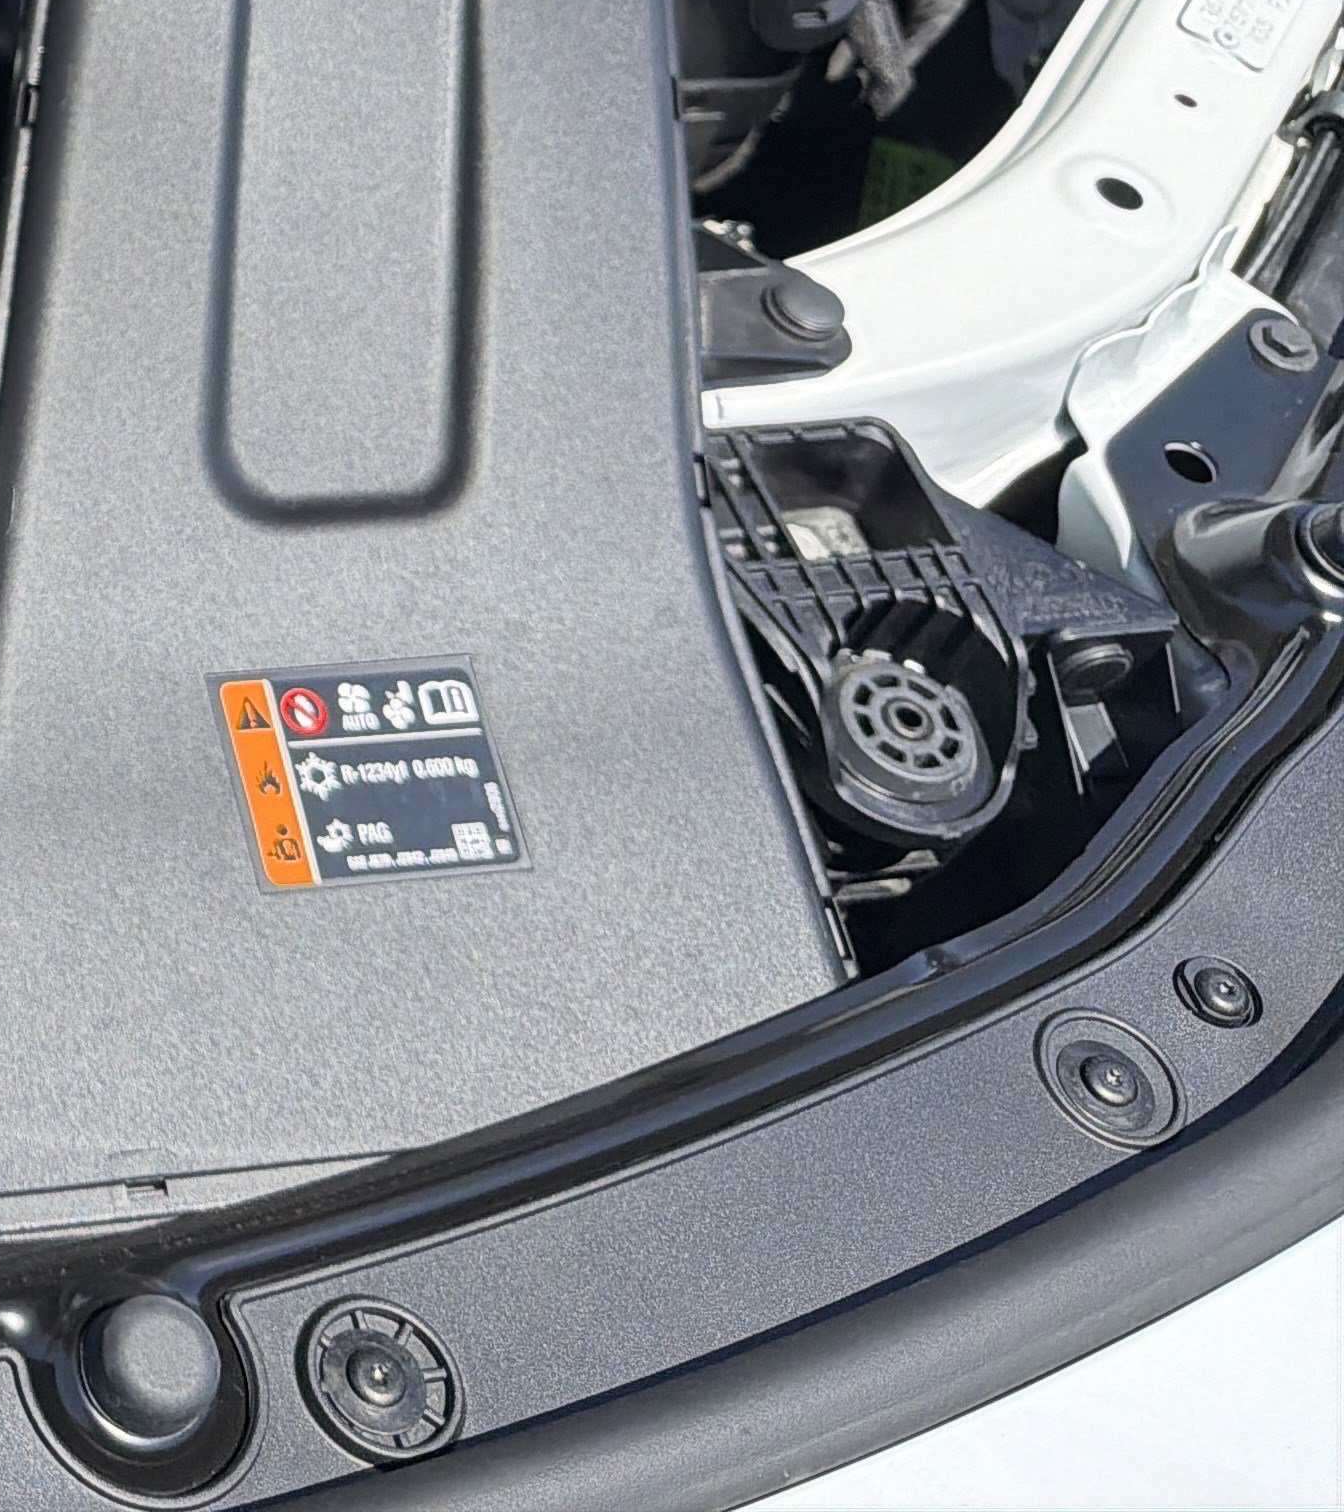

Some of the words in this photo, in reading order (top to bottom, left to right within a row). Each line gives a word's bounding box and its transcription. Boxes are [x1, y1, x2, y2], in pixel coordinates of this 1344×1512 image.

[342, 712, 381, 731] AUTO
[411, 756, 456, 780] 0.600
[456, 757, 479, 779] kg
[356, 821, 394, 845] PAG
